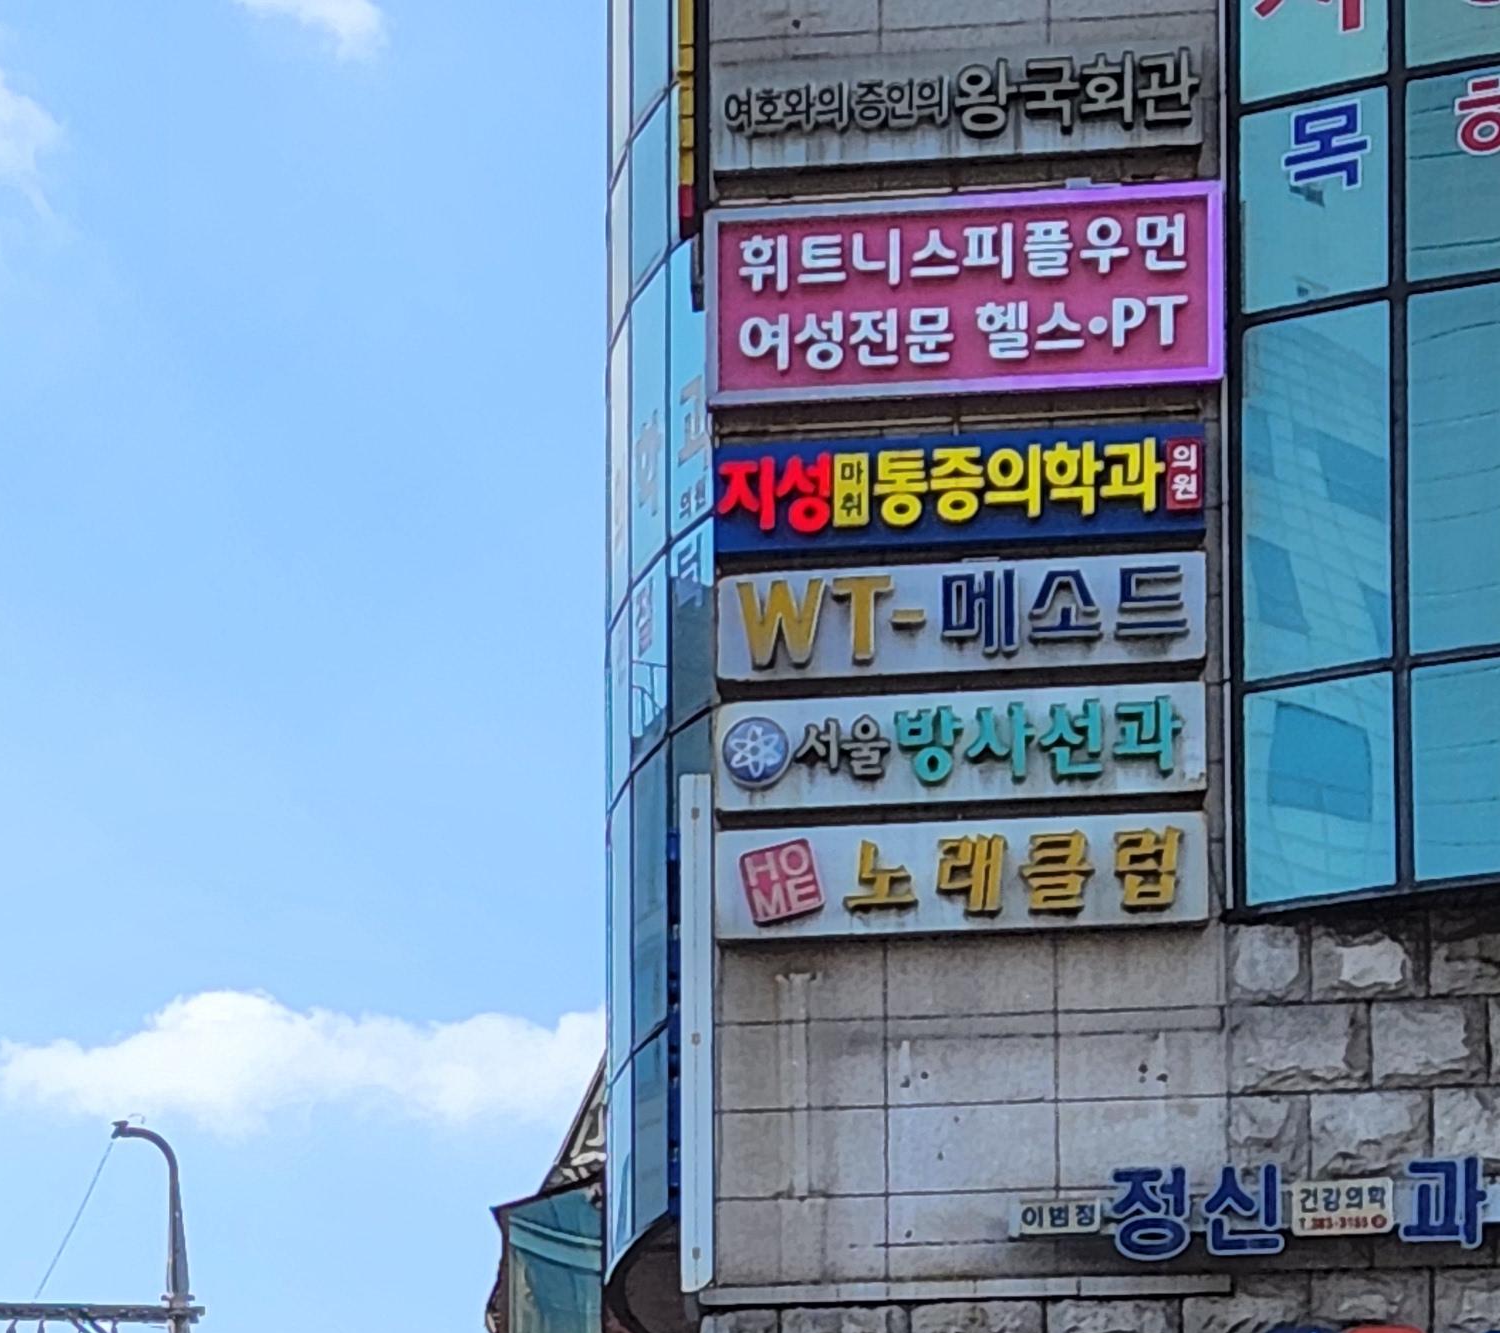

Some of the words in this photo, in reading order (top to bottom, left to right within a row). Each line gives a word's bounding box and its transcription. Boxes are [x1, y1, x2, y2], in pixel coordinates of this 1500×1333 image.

[722, 80, 848, 138] 여호와의
[852, 78, 950, 135] 증인의
[953, 48, 1199, 136] 왕국회관
[1281, 99, 1371, 190] 목
[738, 212, 1190, 293] 휘트니스피플우먼
[738, 308, 955, 372] 여성전문
[717, 456, 832, 532] 지성
[836, 458, 867, 524] 마취
[871, 440, 1164, 527] 통증의학과
[1168, 442, 1200, 504] 의원
[794, 715, 890, 778] 서울
[895, 695, 1185, 784] 방사선과
[744, 843, 812, 885] HO
[750, 878, 822, 922] ME
[843, 825, 1183, 915] 노래클럽
[1110, 1162, 1287, 1258] 정신
[1402, 1155, 1486, 1248] 과
